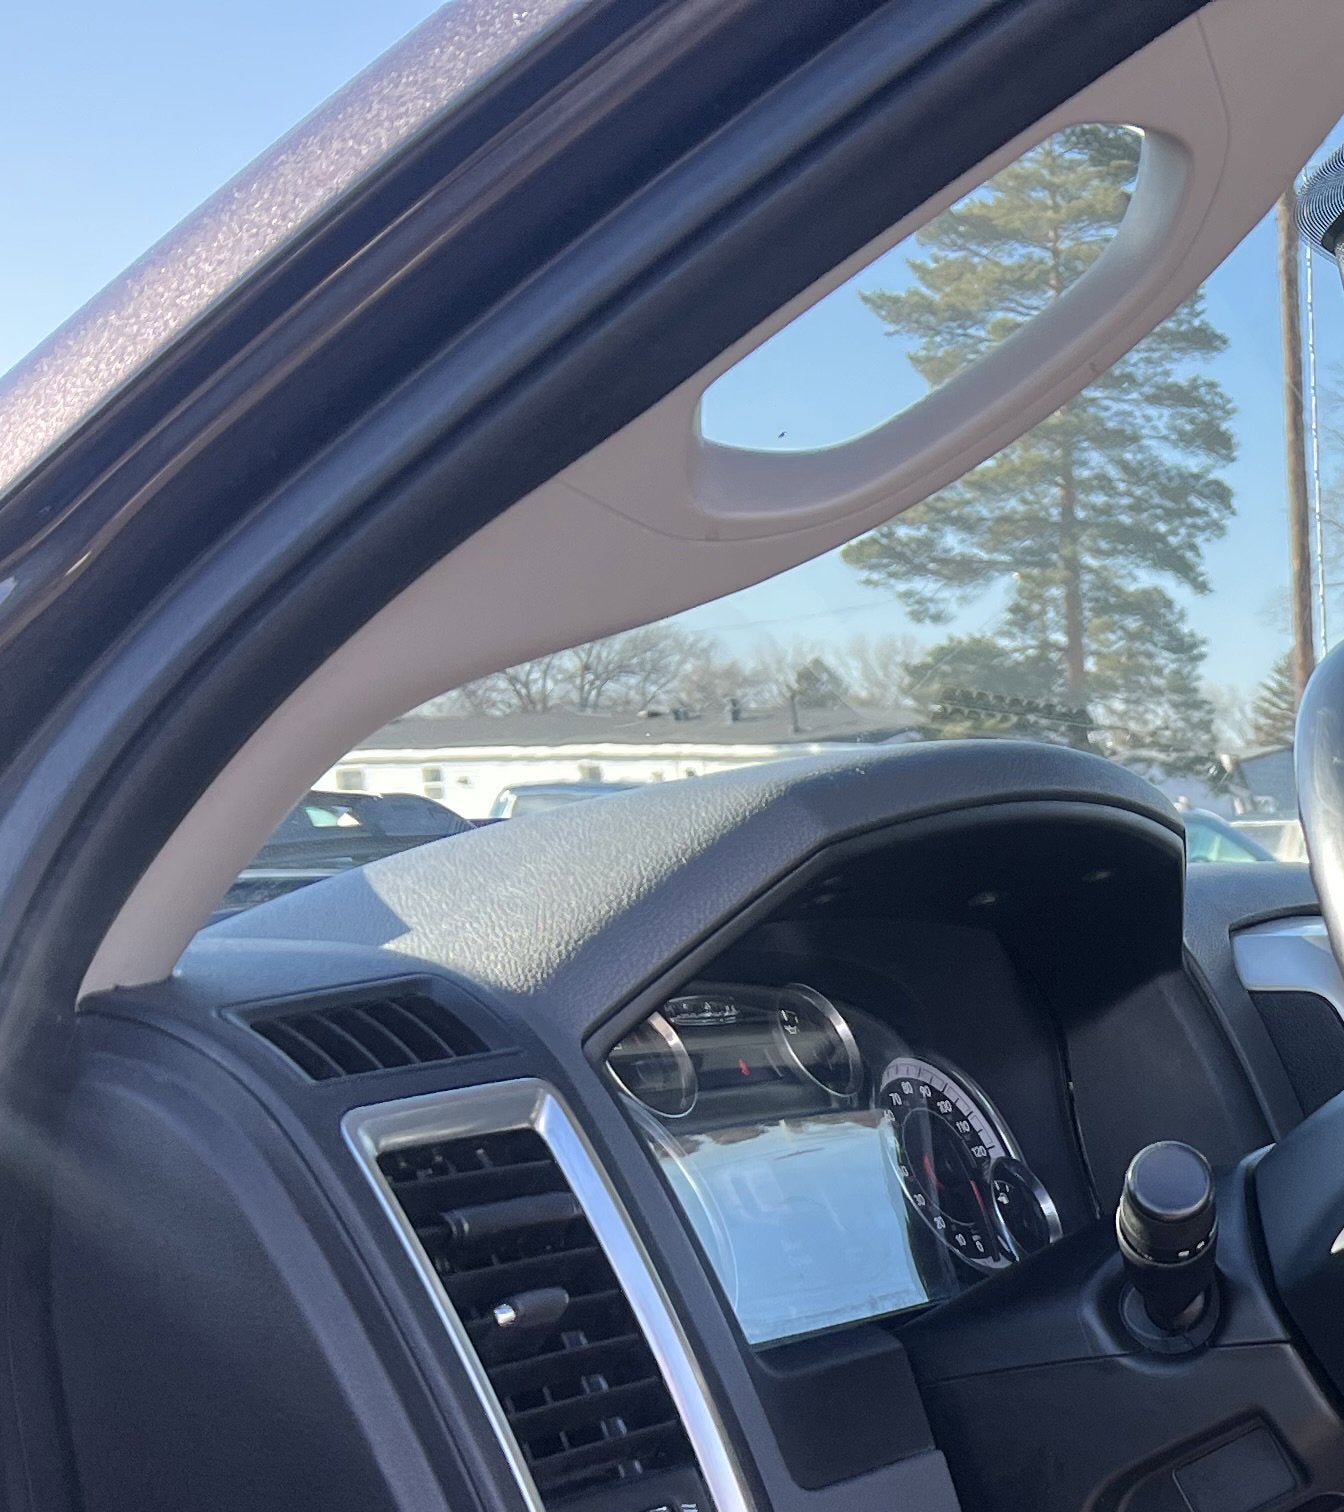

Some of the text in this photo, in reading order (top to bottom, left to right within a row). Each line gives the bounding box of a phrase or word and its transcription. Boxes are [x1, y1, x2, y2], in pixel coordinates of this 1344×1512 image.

[902, 1082, 913, 1094] 80
[919, 1085, 932, 1098] 90
[889, 1093, 902, 1105] 70
[937, 1099, 952, 1114] 100
[956, 1120, 970, 1133] 110
[972, 1146, 986, 1157] 120
[934, 1216, 945, 1229] 20
[955, 1234, 966, 1246] 10
